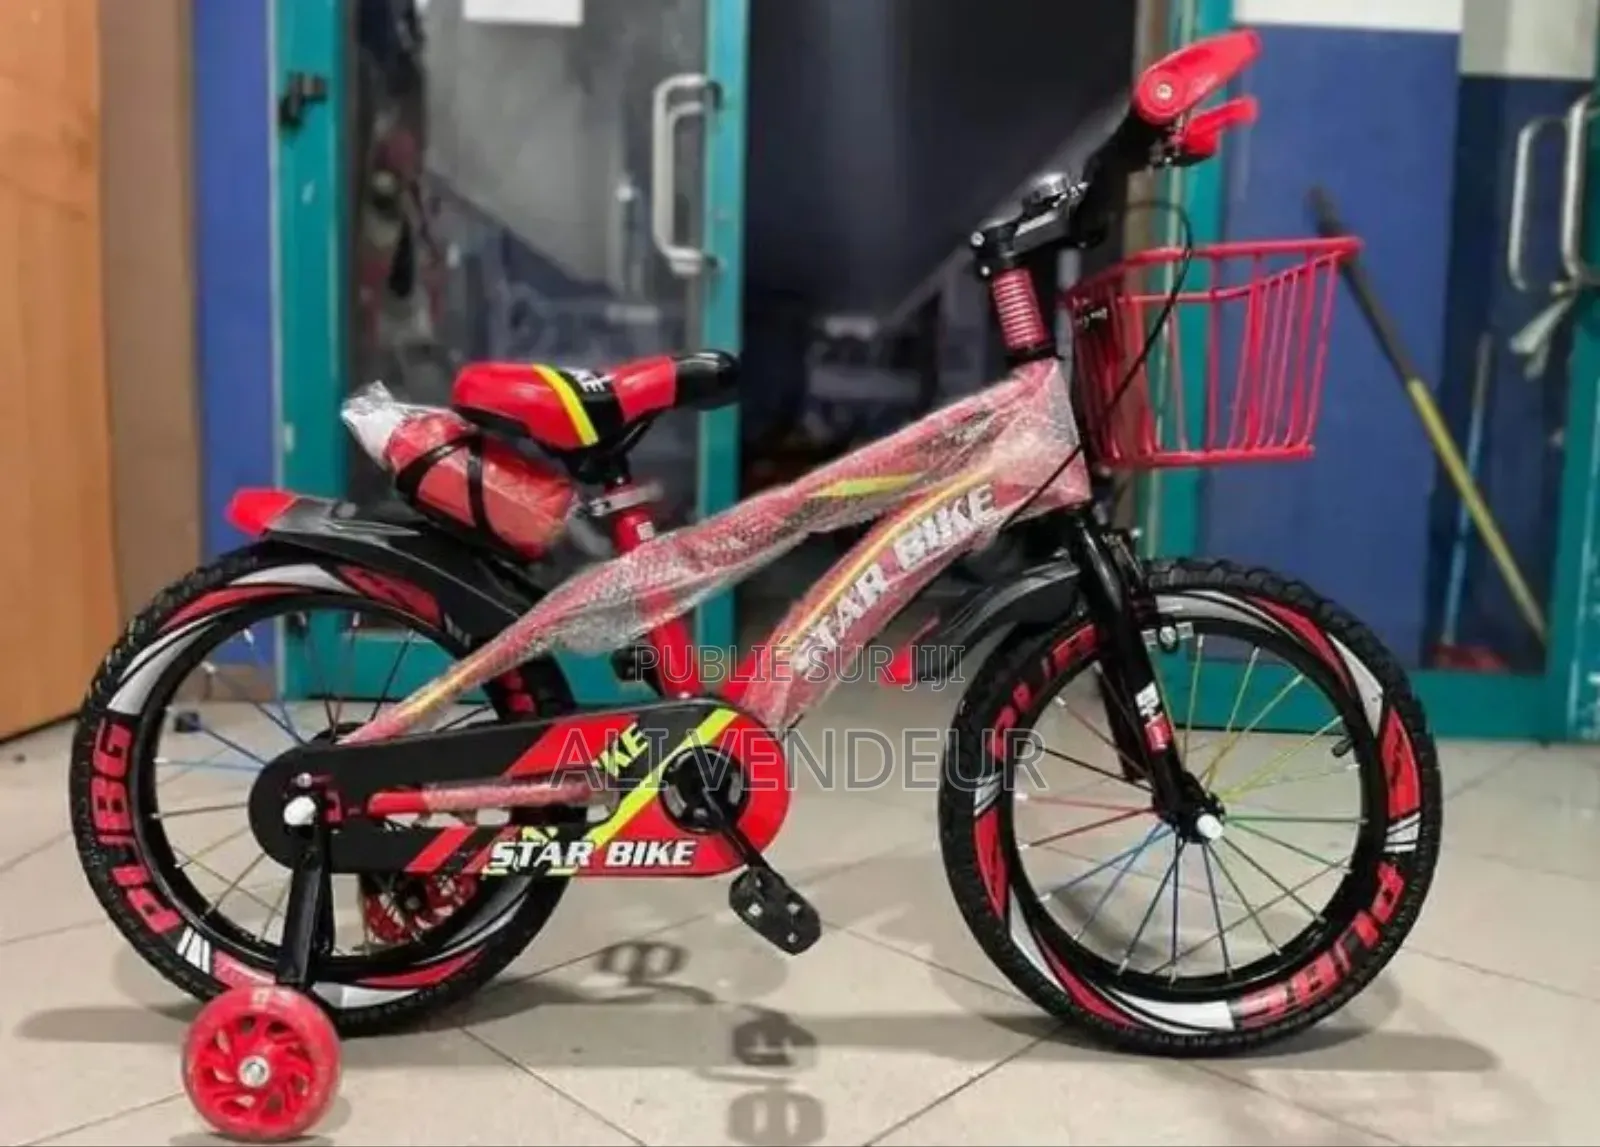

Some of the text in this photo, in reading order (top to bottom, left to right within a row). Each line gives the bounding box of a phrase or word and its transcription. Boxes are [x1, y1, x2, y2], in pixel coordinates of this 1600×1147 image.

[789, 483, 996, 676] STAR BIKE
[490, 841, 697, 868] STAR BIKE
